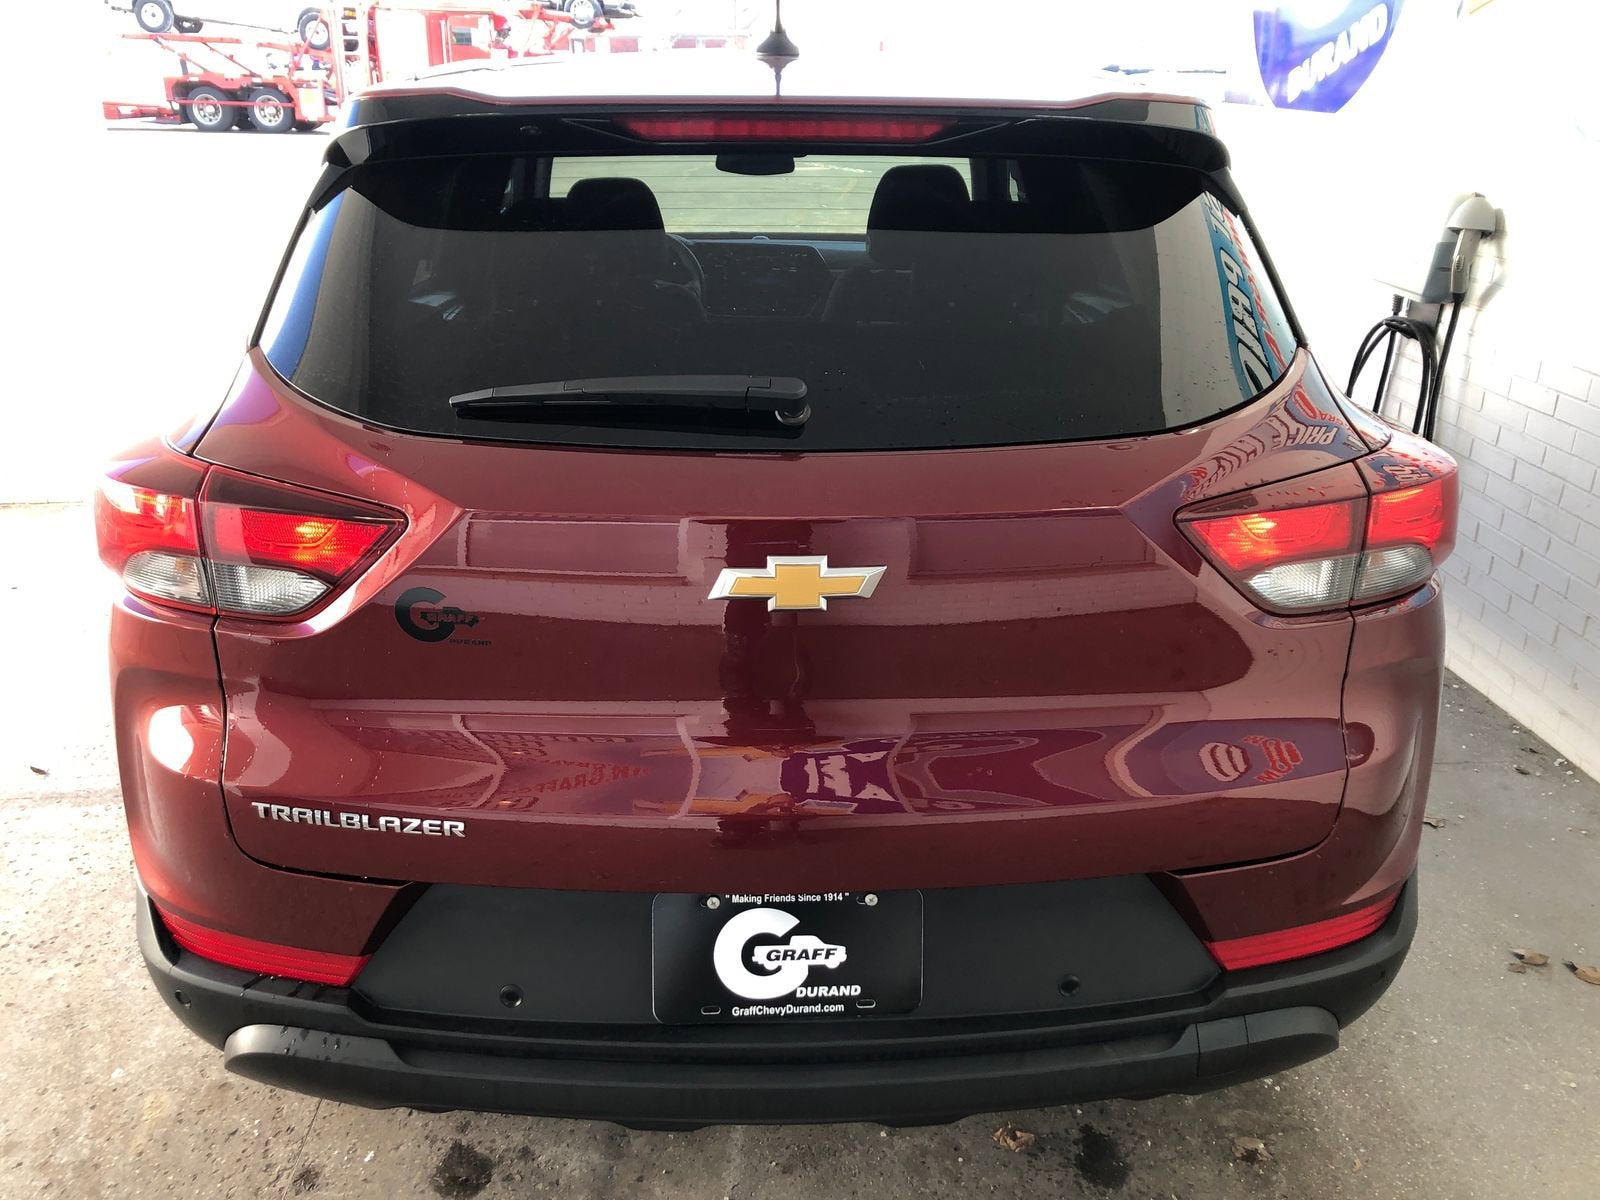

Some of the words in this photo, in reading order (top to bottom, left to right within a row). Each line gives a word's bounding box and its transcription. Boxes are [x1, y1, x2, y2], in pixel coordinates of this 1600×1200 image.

[1287, 3, 1389, 104] DURAND
[251, 801, 466, 838] TRAILBLAZER
[732, 894, 762, 905] Making
[764, 893, 796, 903] Friends
[798, 893, 821, 902] Since
[823, 892, 843, 902] 1914
[766, 947, 838, 962] GRAFF
[796, 984, 862, 998] DURAND
[732, 1003, 845, 1017] GraffChevyDurand.com
